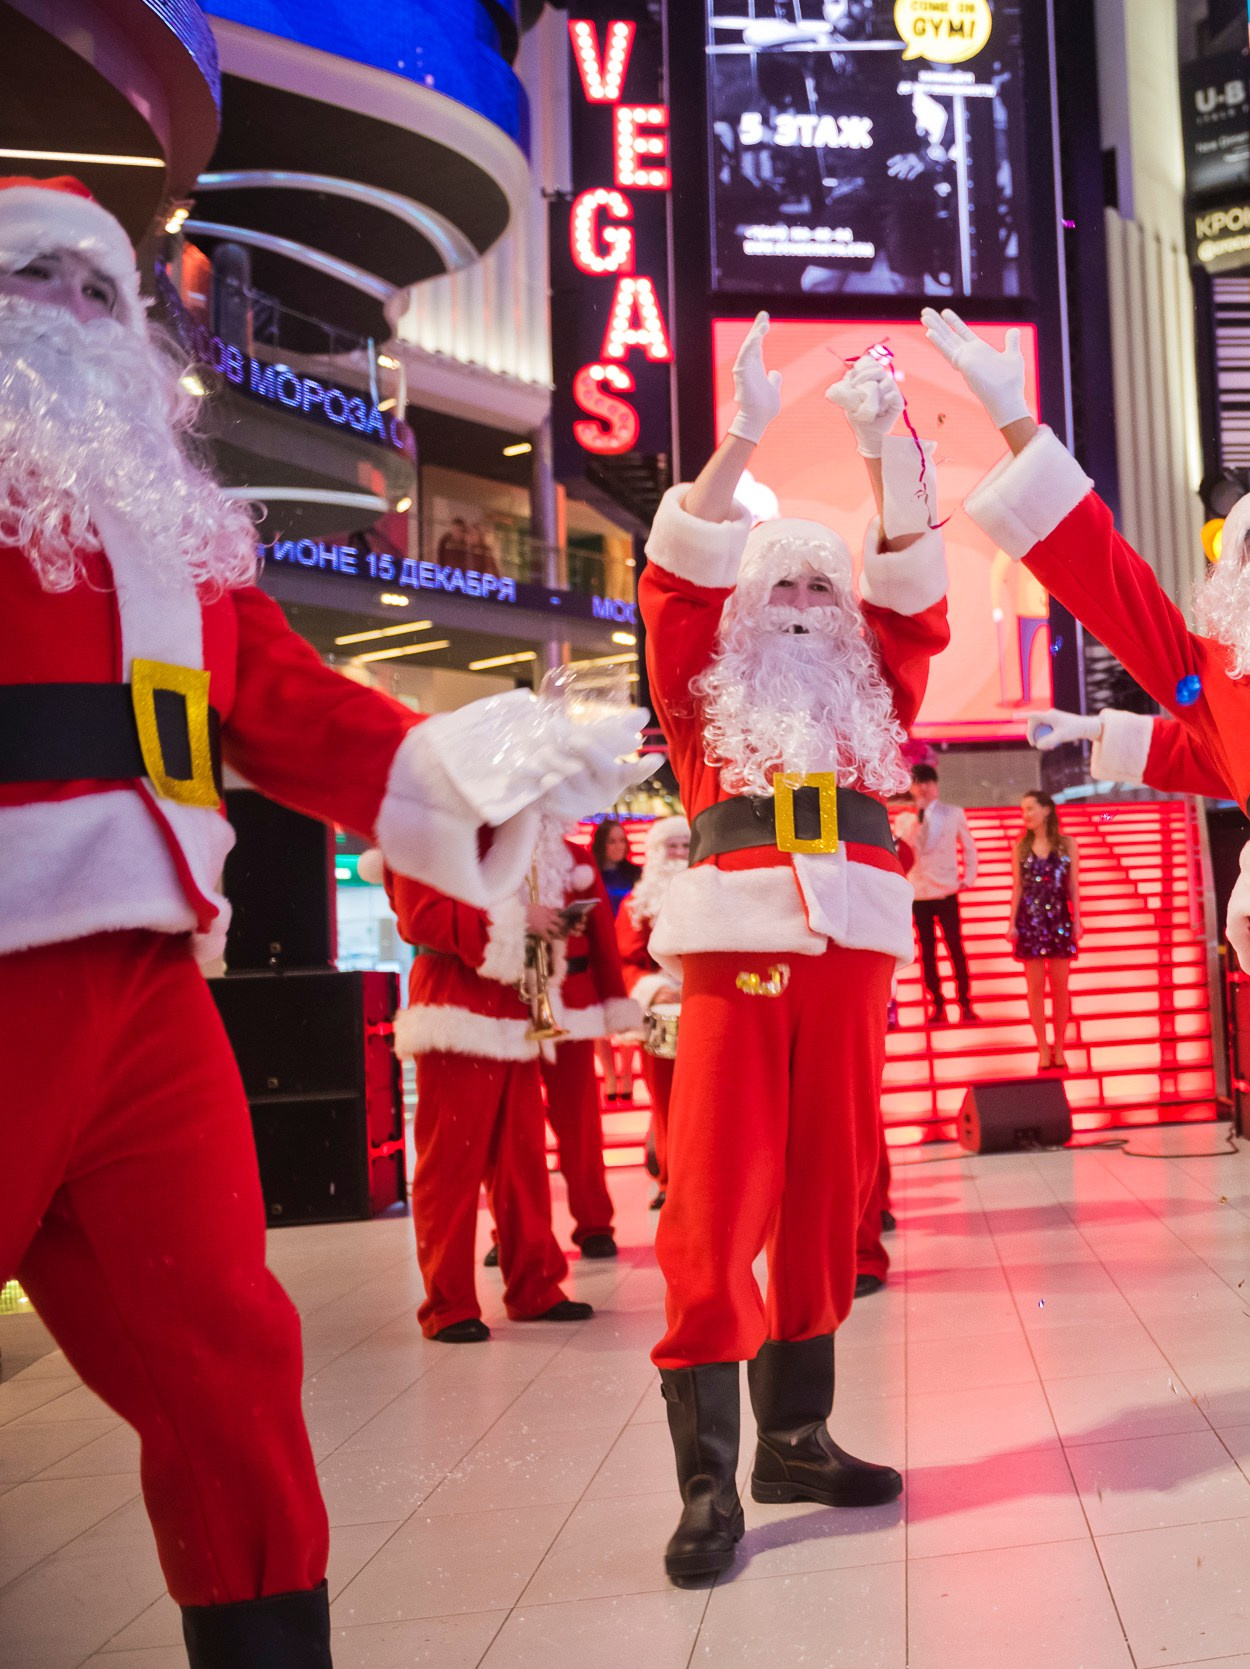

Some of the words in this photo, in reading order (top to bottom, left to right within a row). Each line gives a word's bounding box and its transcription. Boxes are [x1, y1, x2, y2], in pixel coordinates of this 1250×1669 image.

[913, 17, 976, 39] GYM!
[739, 112, 763, 145] 5
[773, 113, 874, 149] ЭТАЖ
[568, 19, 674, 455] VEGAS
[250, 358, 387, 440] МОРОЗА
[365, 551, 396, 581] 15
[400, 557, 516, 602] ДЕКАБРЯ
